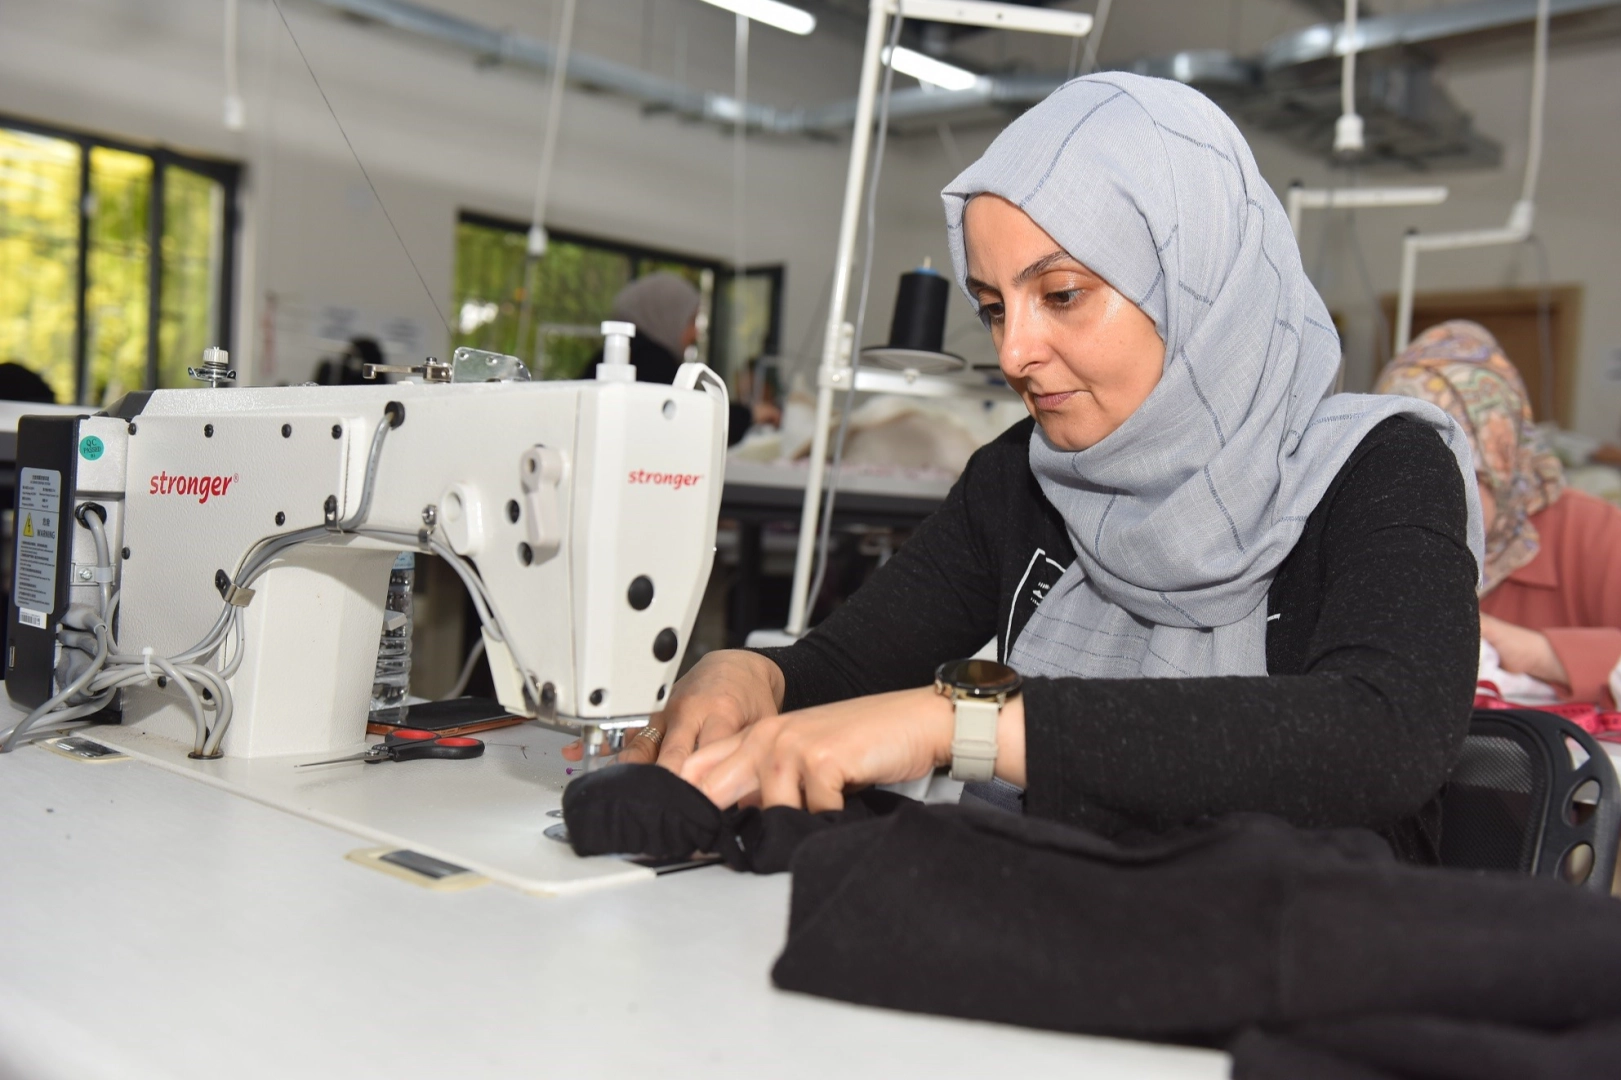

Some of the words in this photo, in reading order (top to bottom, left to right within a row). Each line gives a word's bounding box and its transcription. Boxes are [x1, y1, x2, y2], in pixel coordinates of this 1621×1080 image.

[86, 438, 97, 448] QC
[150, 470, 233, 503] stronger
[628, 469, 699, 490] stronger
[37, 529, 56, 540] WARNING
